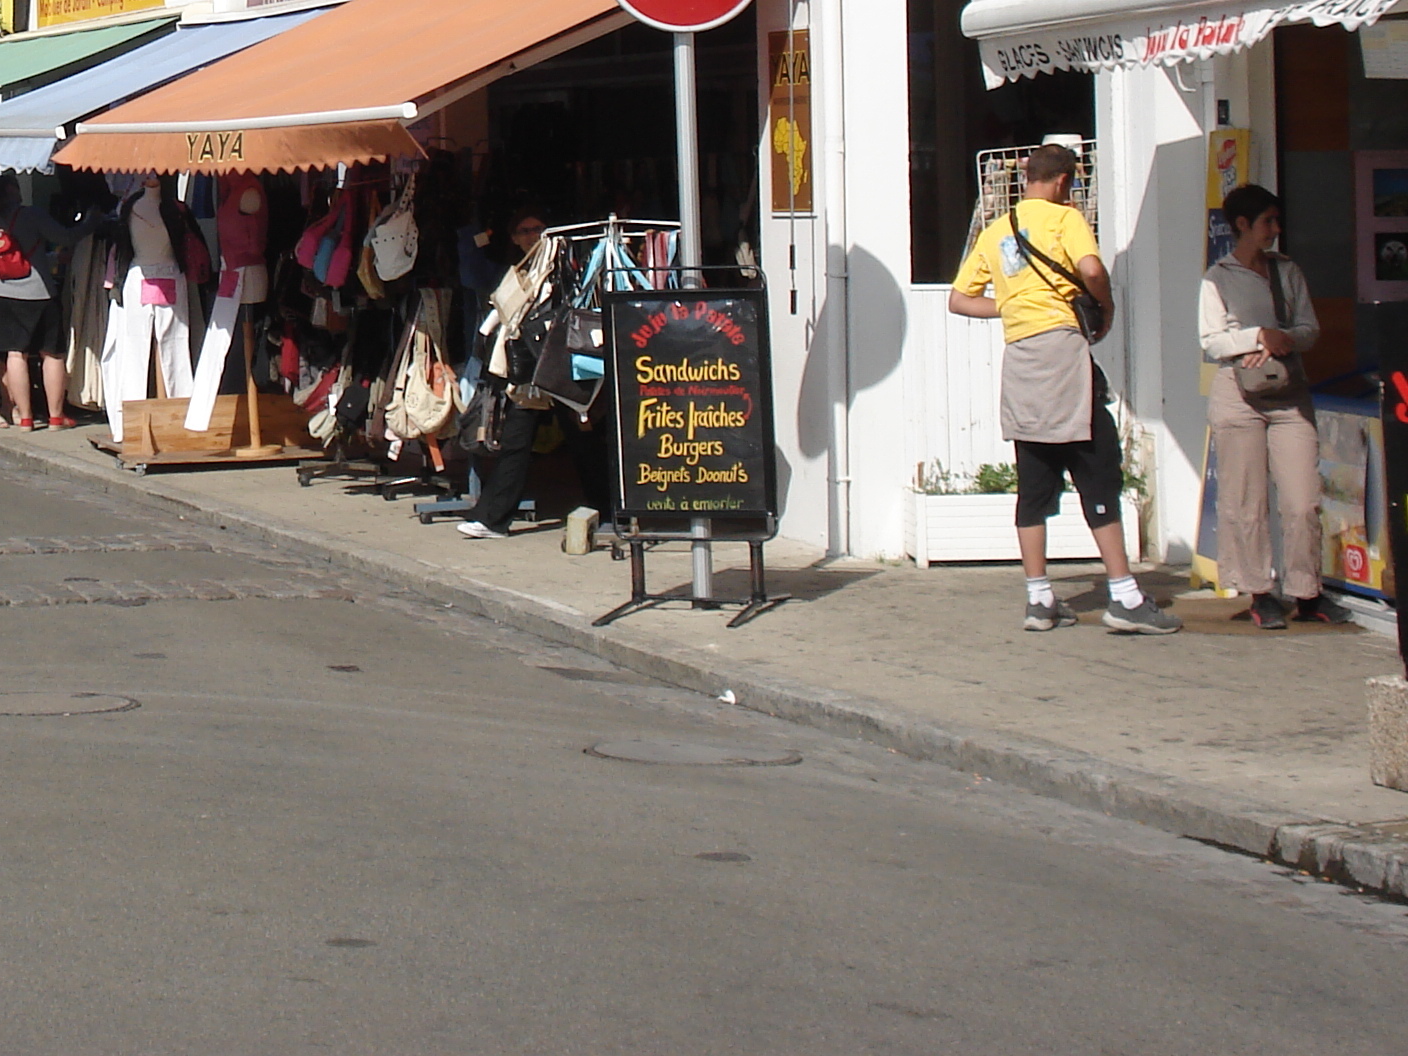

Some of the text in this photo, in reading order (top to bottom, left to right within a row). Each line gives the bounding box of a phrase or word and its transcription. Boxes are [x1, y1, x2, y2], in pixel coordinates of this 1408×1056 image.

[997, 42, 1050, 72] GLACES
[186, 131, 245, 163] YAYA
[670, 301, 690, 321] la
[635, 355, 741, 384] Sandwichs
[638, 397, 684, 439] Frites
[657, 434, 724, 466] Burgers
[636, 463, 691, 492] Beignets
